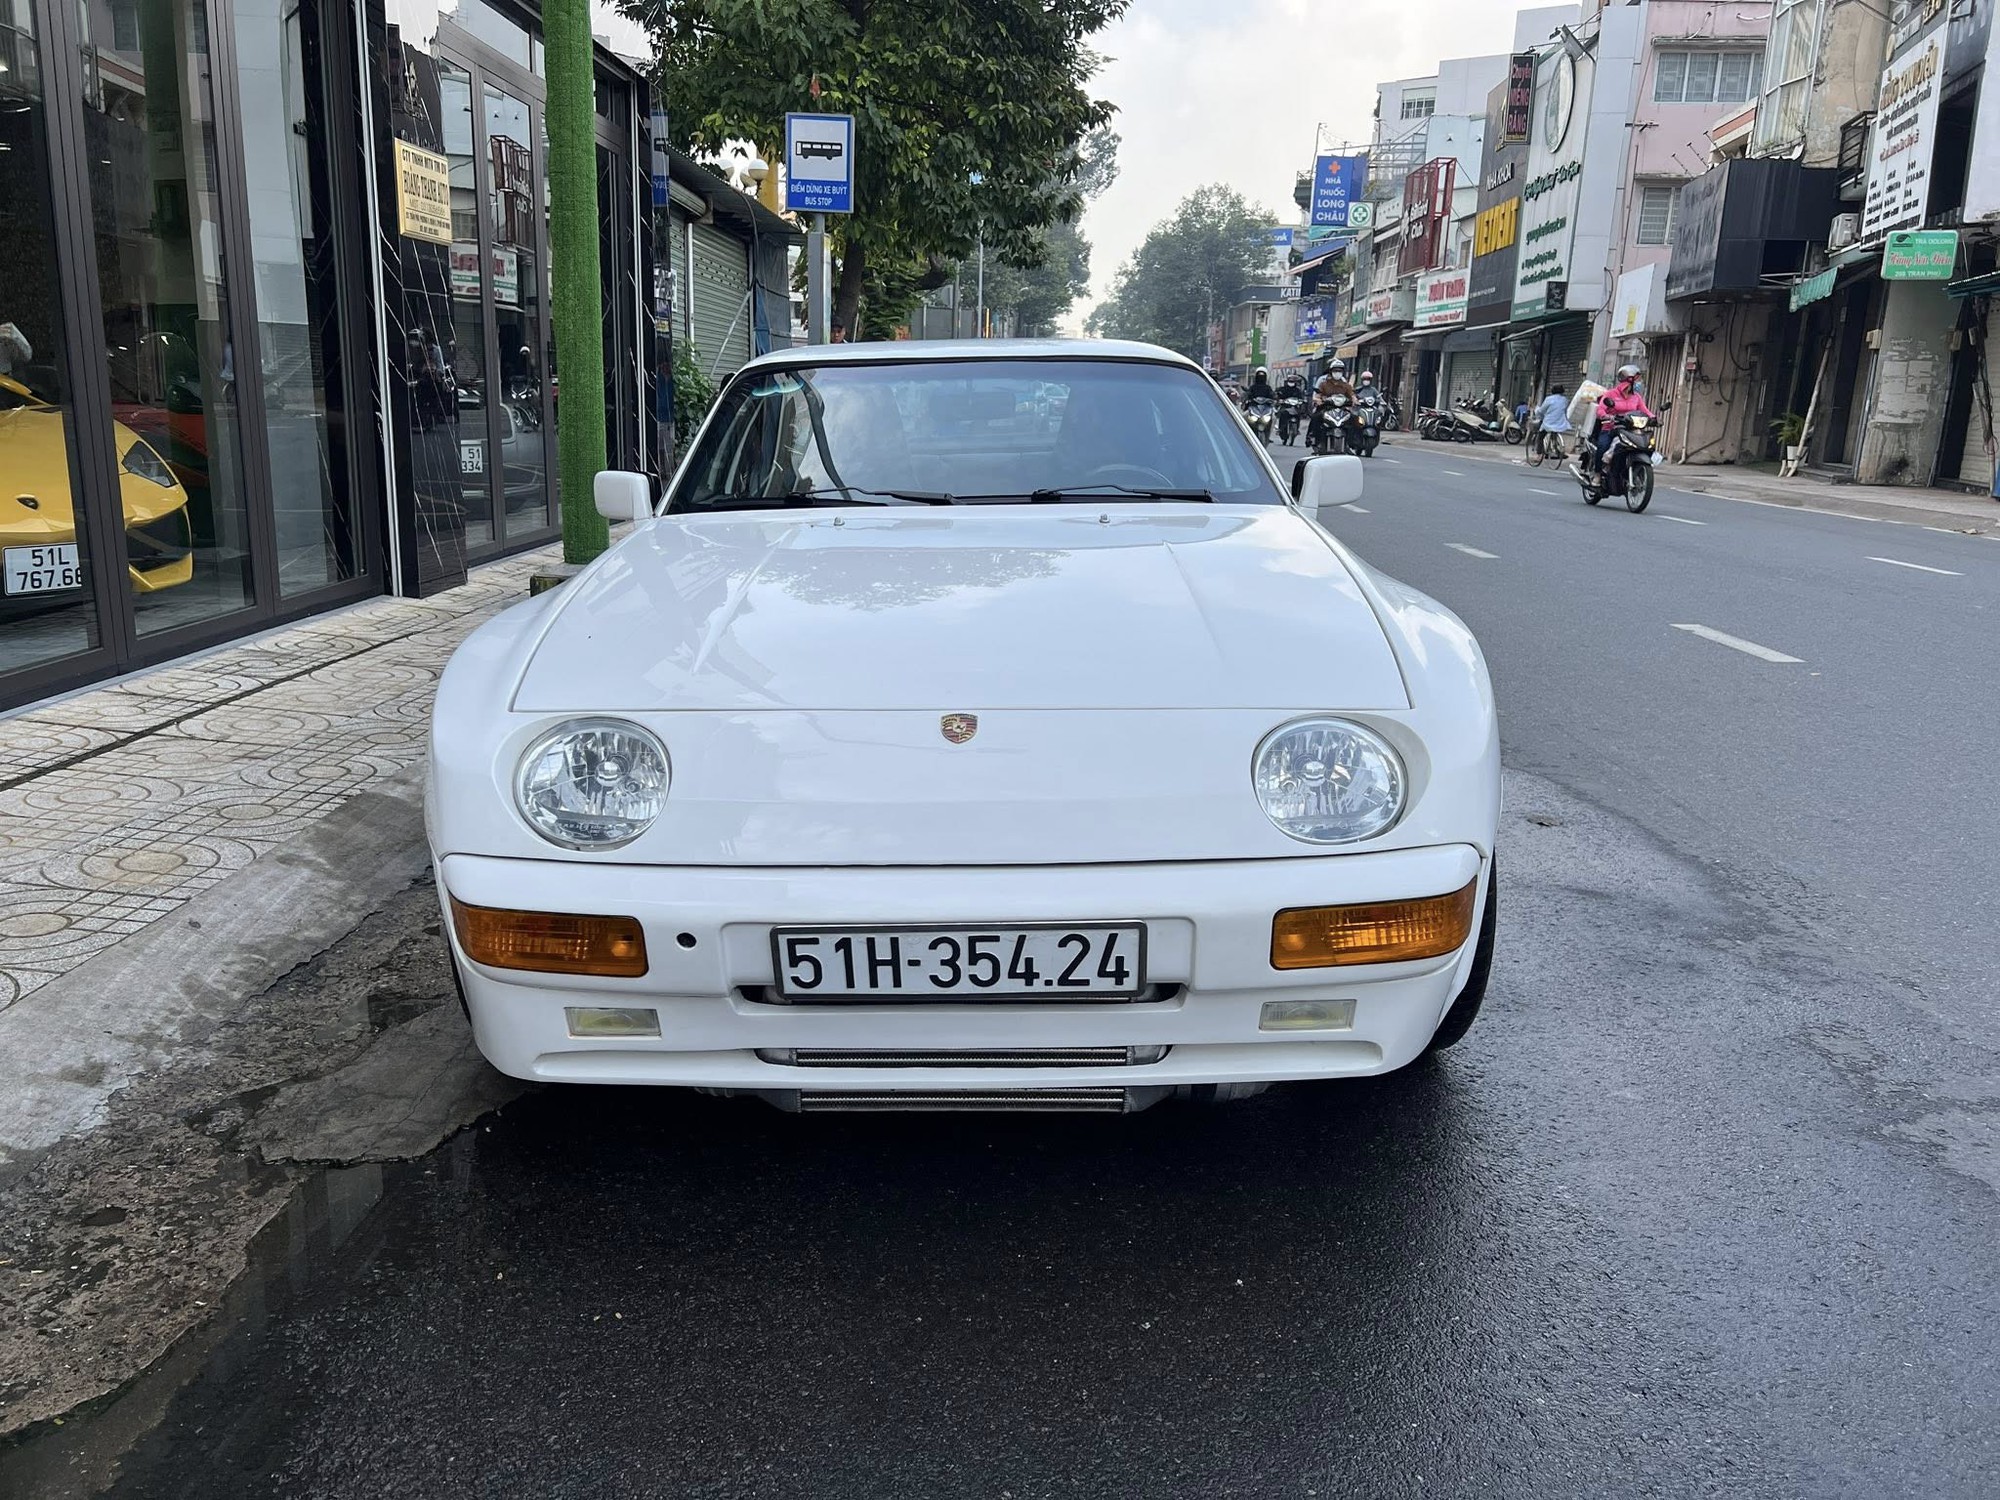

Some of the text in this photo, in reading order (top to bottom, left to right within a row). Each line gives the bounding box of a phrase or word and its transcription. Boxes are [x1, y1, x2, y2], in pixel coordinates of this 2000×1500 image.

[1325, 176, 1341, 184] NHÀ
[791, 181, 848, 195] ĐIỂM DỪNG XE BUÝT
[1320, 187, 1345, 196] THUỐC
[804, 196, 833, 206] BUS STOP
[1317, 200, 1345, 208] LONG
[1316, 211, 1345, 221] CHÂU
[1411, 221, 1424, 239] Club
[468, 448, 481, 459] 51
[462, 460, 481, 471] 334
[31, 547, 70, 568] 51L
[786, 932, 1131, 990] 51H-354.24
